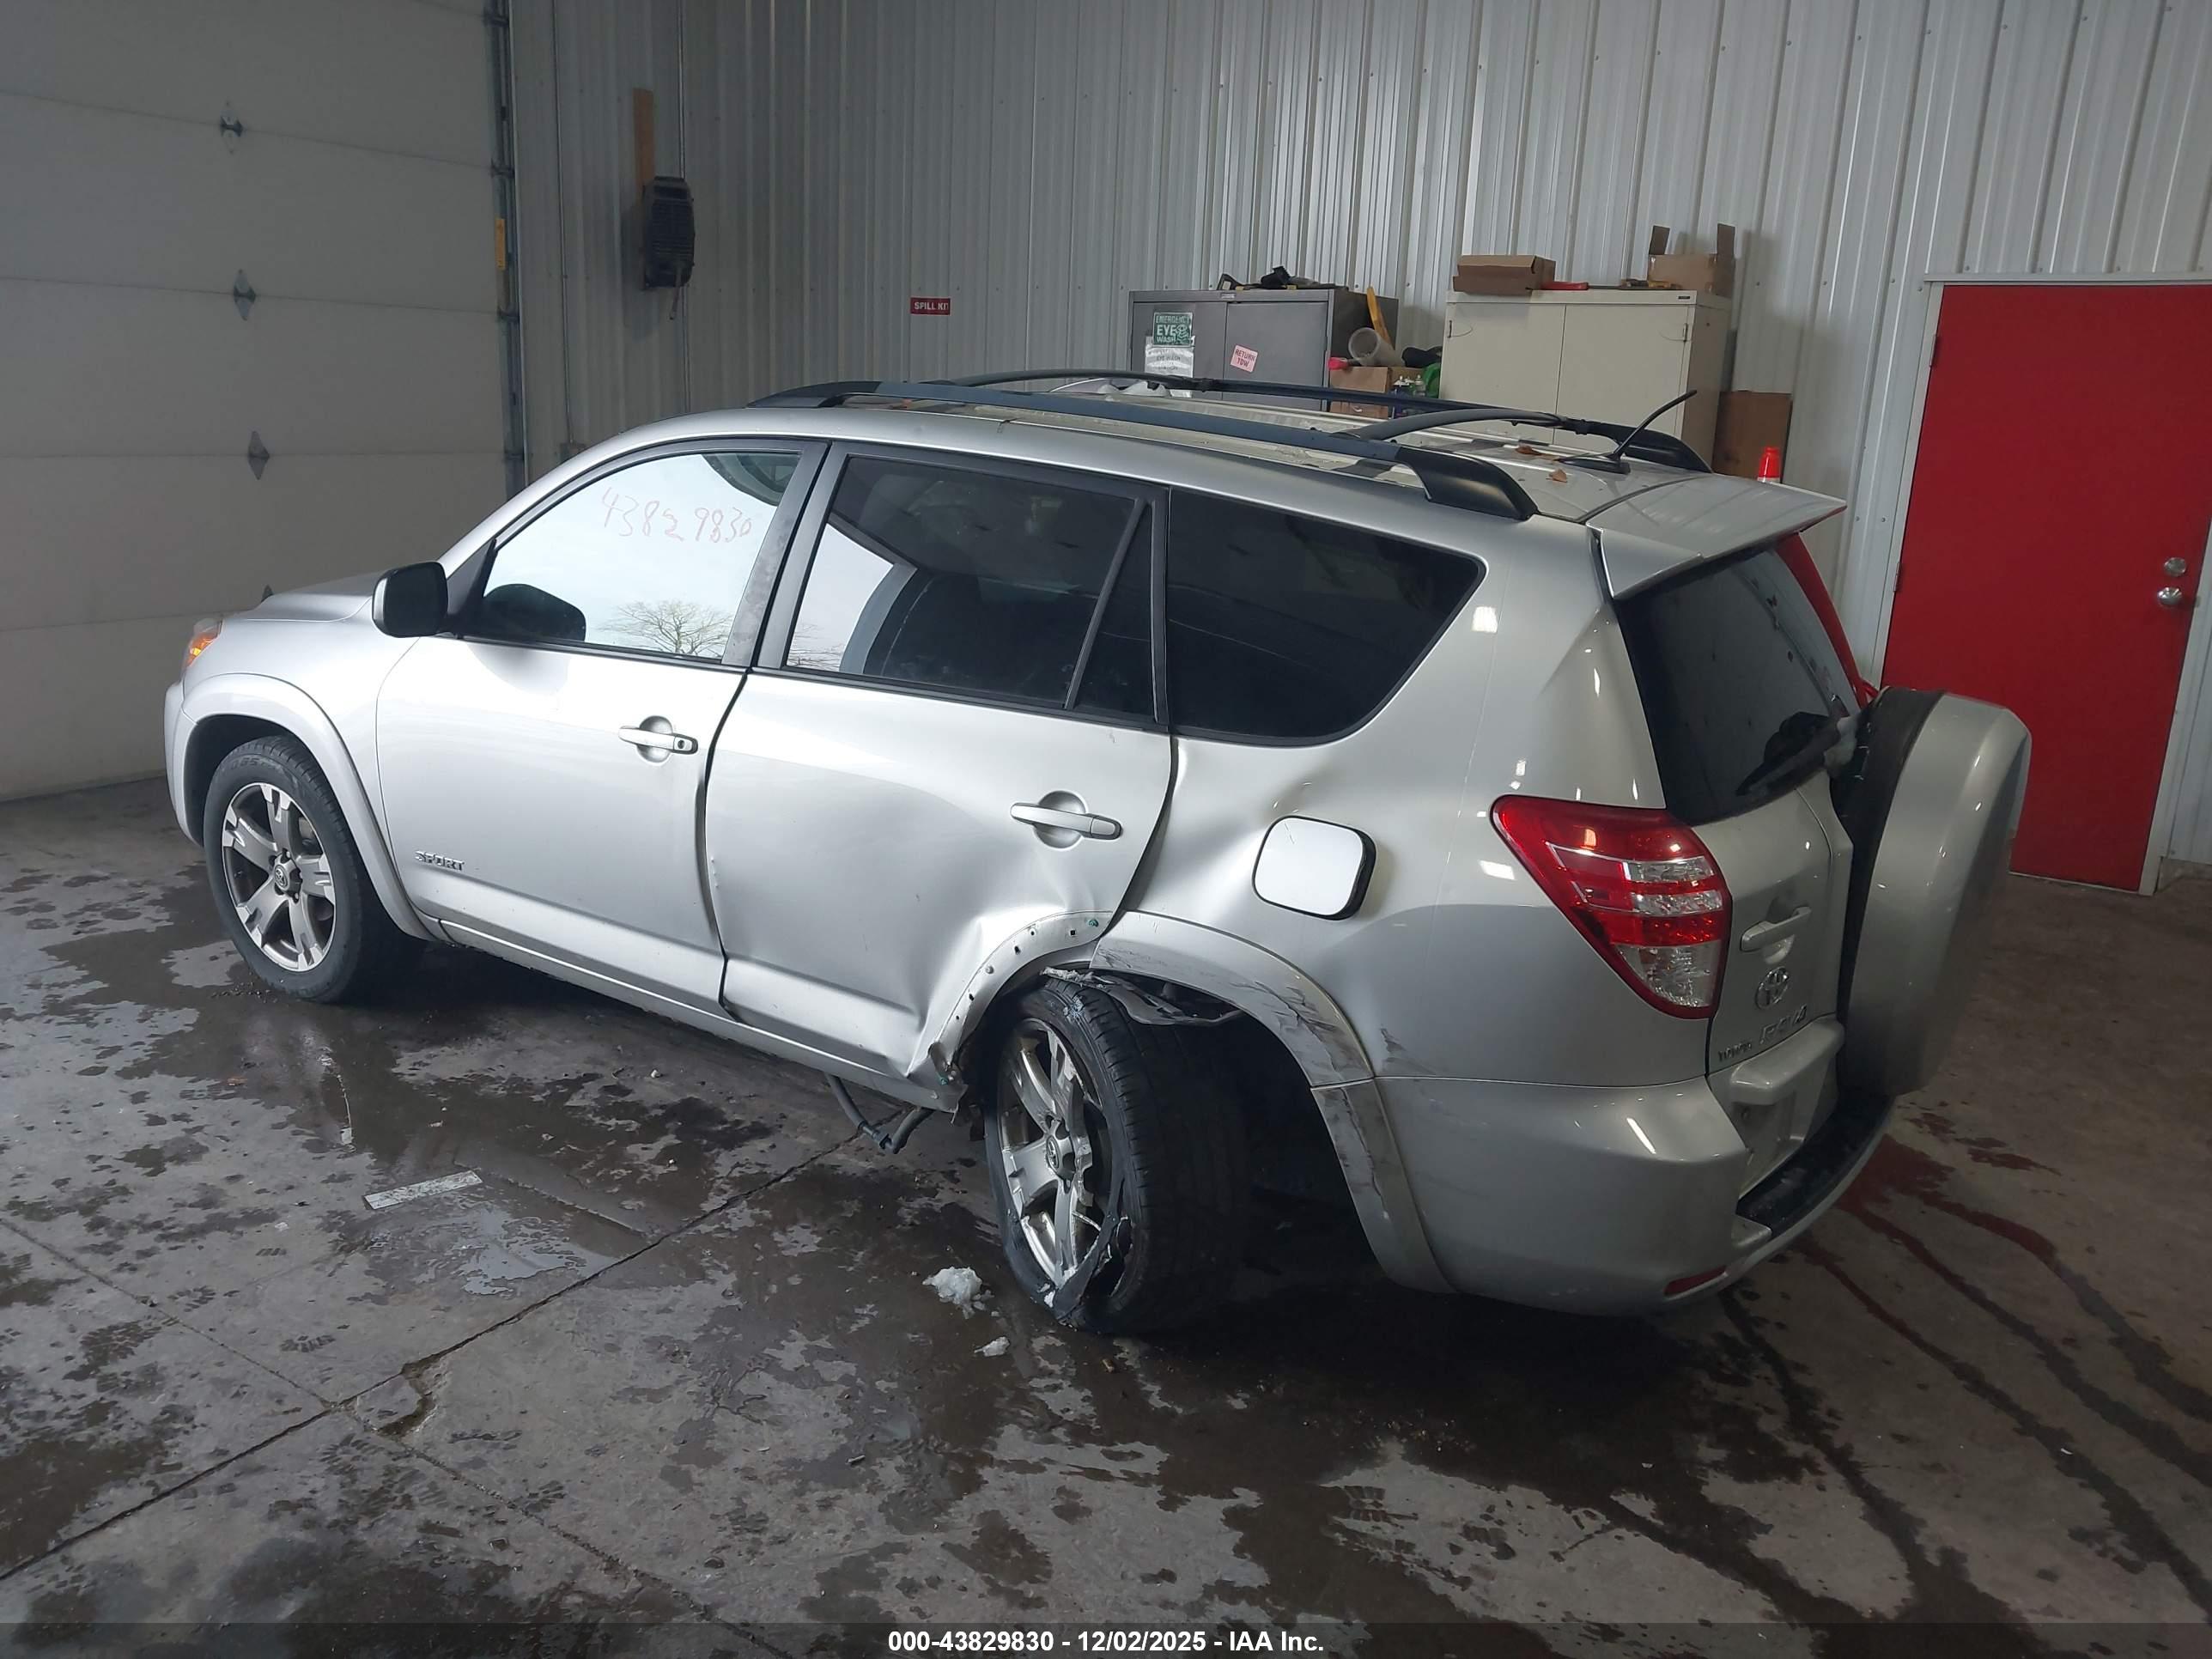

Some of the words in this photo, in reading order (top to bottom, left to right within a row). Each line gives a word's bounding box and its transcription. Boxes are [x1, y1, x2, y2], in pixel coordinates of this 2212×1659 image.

[914, 301, 936, 310] SPILL
[938, 302, 949, 311] KIT
[1156, 315, 1190, 324] EMERGENCY
[1157, 324, 1177, 337] EYE
[1235, 349, 1256, 362] RETURN
[1237, 357, 1250, 367] TOW
[415, 850, 465, 871] SPORT
